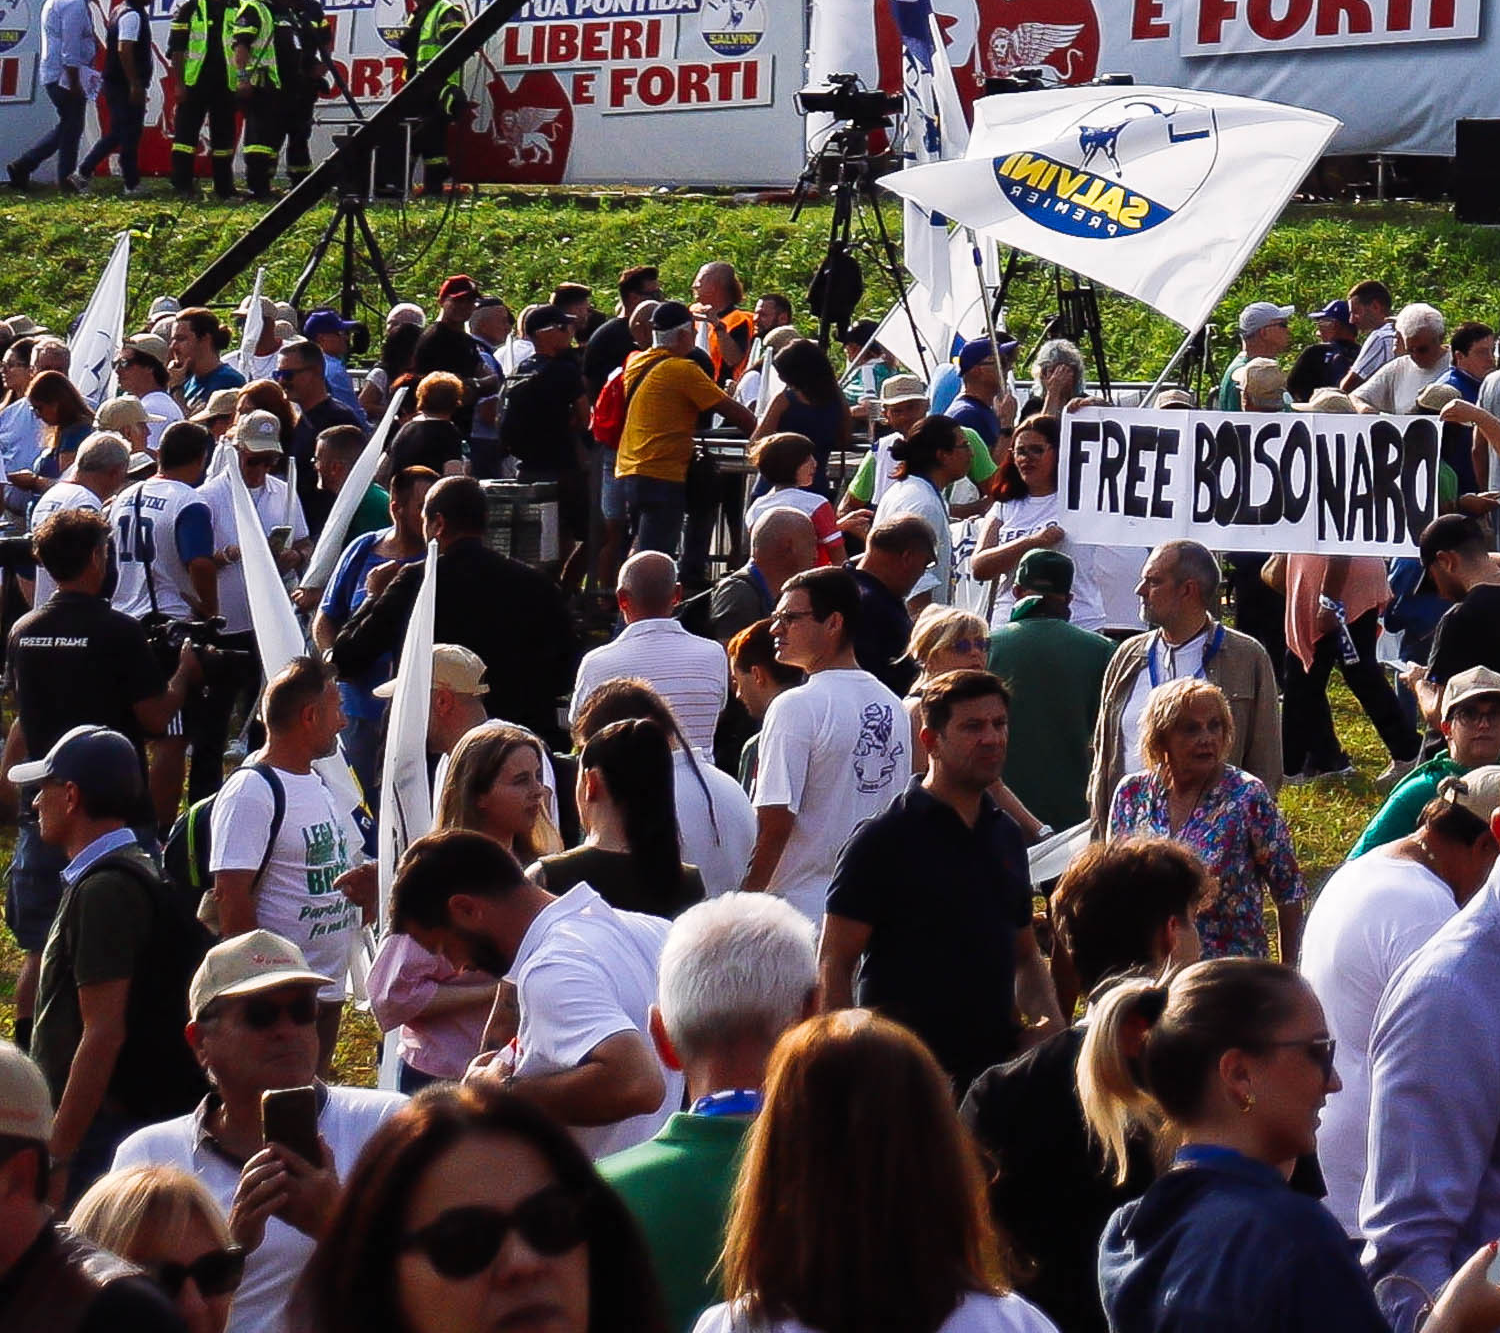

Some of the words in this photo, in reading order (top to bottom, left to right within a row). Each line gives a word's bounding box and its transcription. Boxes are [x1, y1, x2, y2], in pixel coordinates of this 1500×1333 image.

[504, 18, 661, 65] LIBERI
[708, 32, 758, 45] SALVINI
[572, 73, 595, 105] E
[610, 60, 759, 108] FORTI
[1067, 420, 1180, 519] FREE
[1192, 418, 1440, 547] BOLSONARO
[54, 637, 89, 648] FRAME
